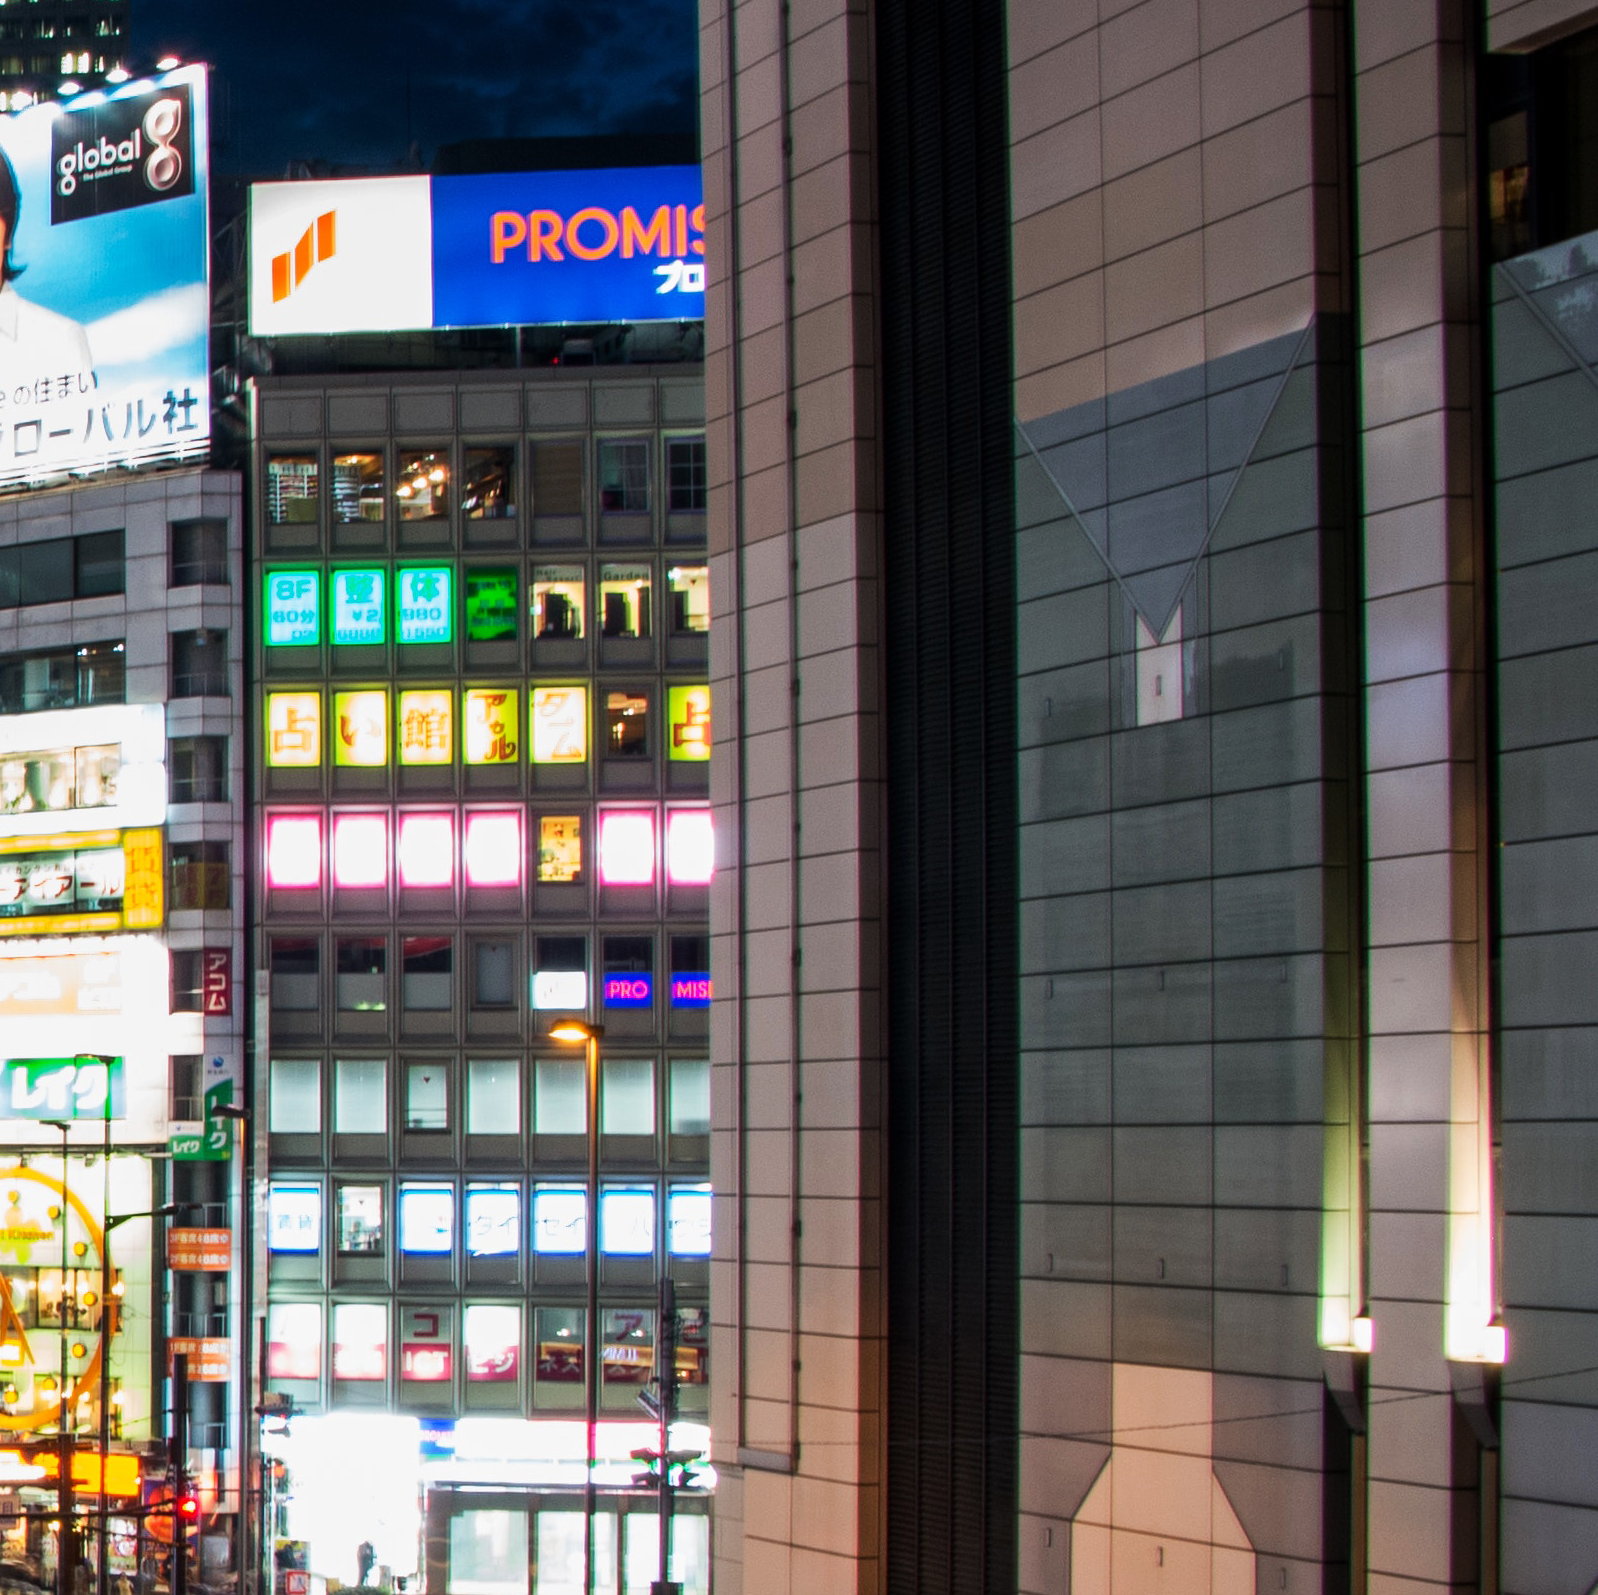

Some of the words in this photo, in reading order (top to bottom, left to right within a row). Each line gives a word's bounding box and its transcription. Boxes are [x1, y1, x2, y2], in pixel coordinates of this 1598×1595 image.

[57, 128, 140, 196] global
[13, 371, 98, 405] の住まい
[276, 579, 311, 600] 8F
[209, 953, 227, 1011] アコム
[608, 980, 648, 999] PRO
[11, 1065, 109, 1110] レイク
[172, 1139, 201, 1154] レイク
